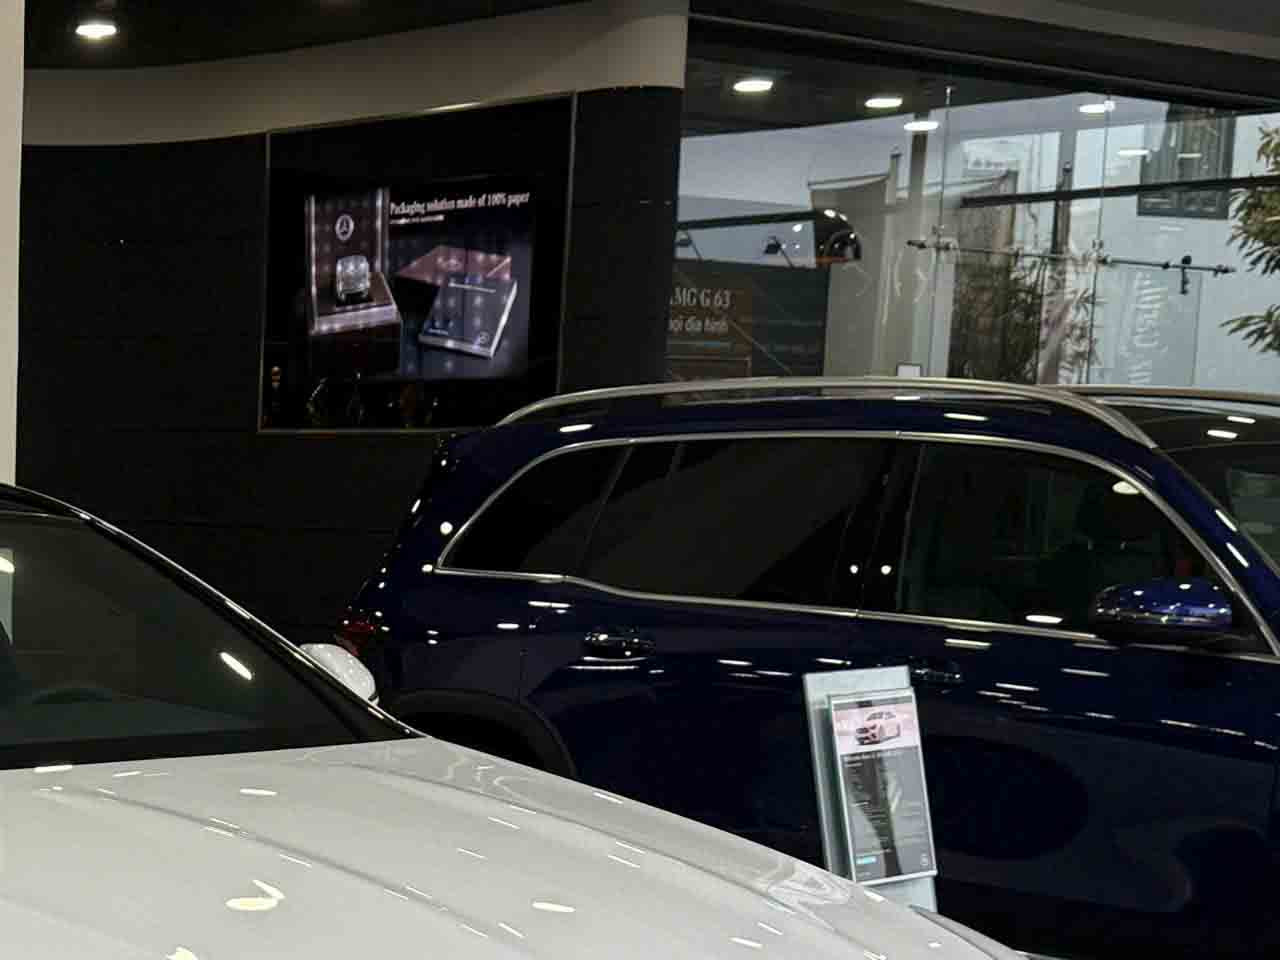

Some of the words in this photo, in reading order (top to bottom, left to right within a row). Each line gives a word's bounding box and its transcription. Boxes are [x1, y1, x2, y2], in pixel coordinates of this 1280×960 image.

[456, 195, 477, 209] made
[477, 193, 487, 207] of
[487, 192, 507, 207] 100%
[507, 191, 530, 208] paper
